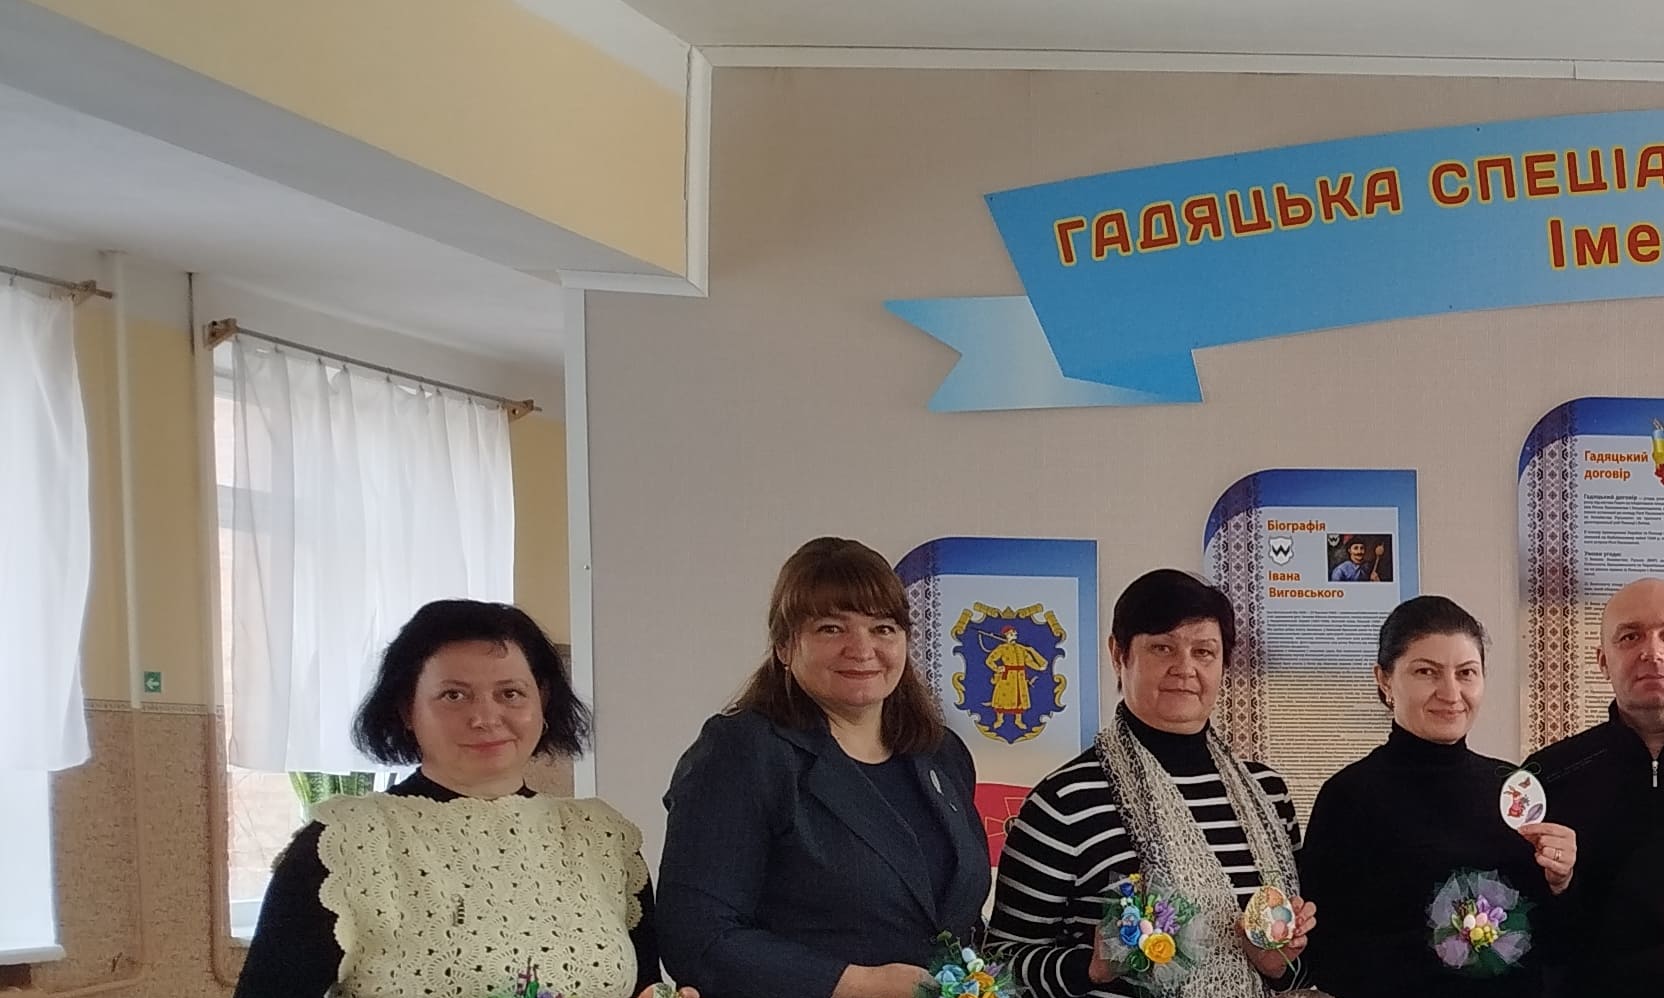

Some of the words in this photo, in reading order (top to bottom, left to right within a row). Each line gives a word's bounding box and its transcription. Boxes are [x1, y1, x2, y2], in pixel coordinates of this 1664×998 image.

[1056, 170, 1400, 264] ГАДЯЦЬКА
[1585, 450, 1648, 463] Гадяцький
[1584, 468, 1631, 481] договір
[1267, 520, 1326, 533] Біографія
[1269, 571, 1301, 582] Івана
[1269, 587, 1344, 598] Виговського
